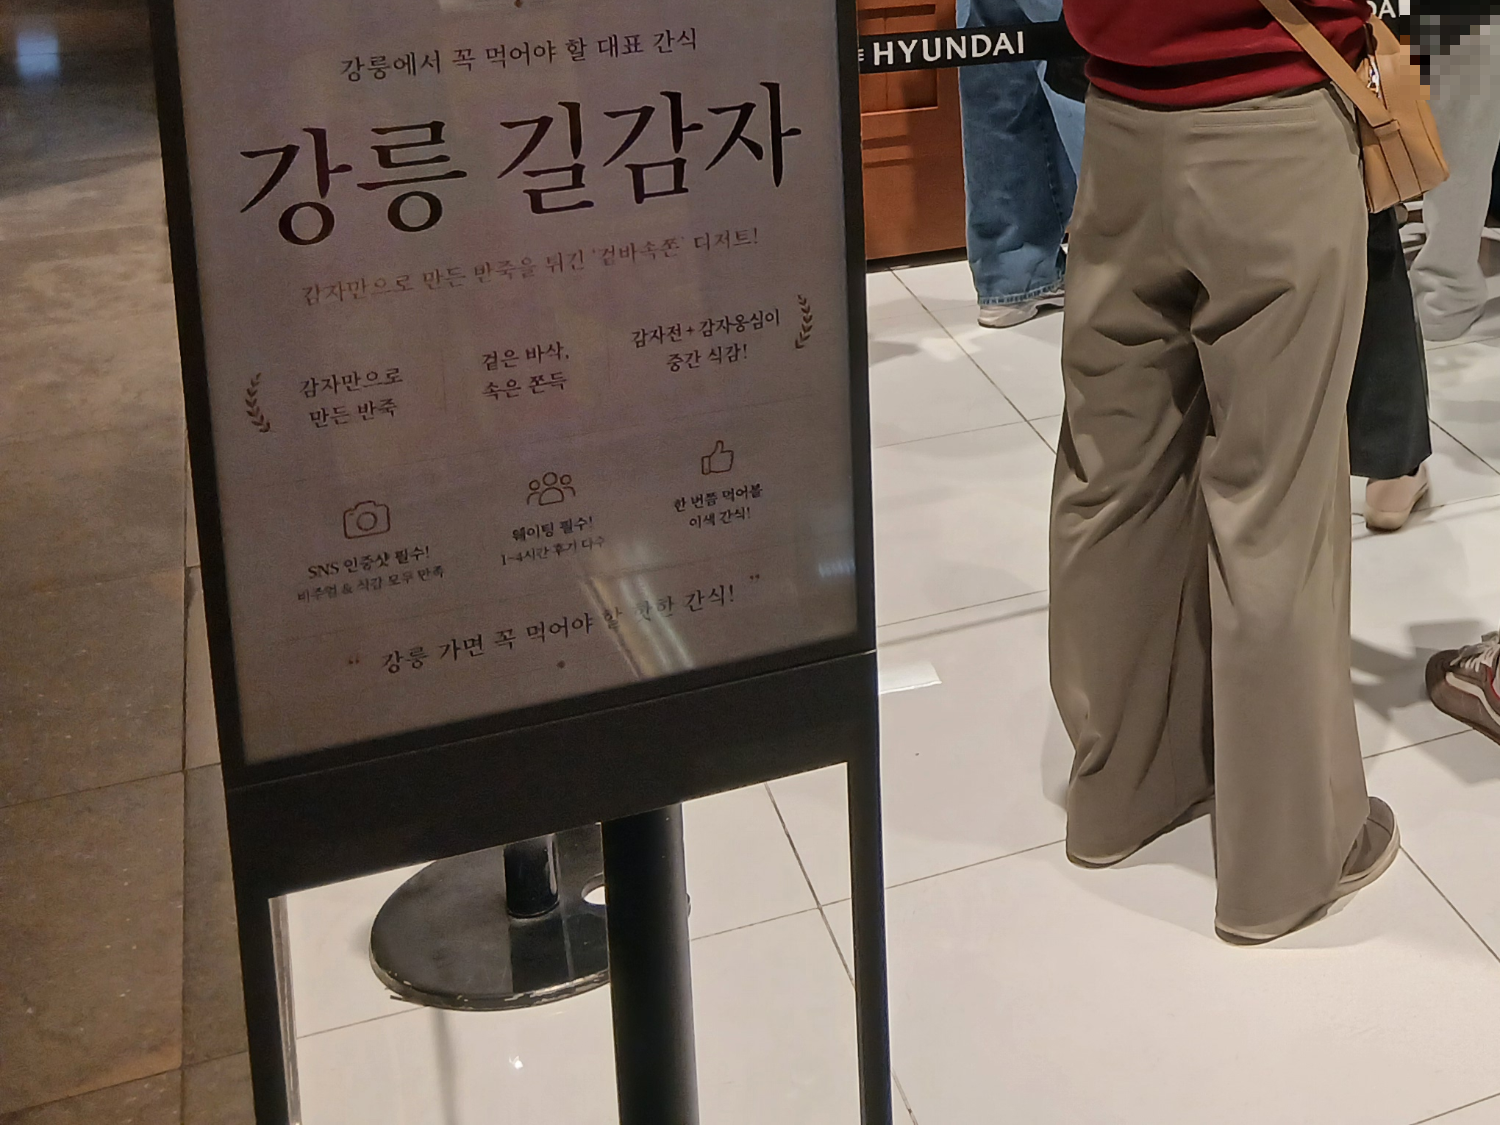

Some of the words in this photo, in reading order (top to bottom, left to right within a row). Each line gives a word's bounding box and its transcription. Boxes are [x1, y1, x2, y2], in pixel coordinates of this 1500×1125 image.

[342, 50, 440, 82] 강릉에서
[453, 48, 475, 71] 꼭
[486, 40, 556, 68] 먹어야
[565, 37, 587, 62] 할
[597, 34, 643, 58] 대표
[654, 28, 696, 53] 간식
[873, 30, 1025, 66] HYUNDAI
[240, 121, 467, 245] 강릉
[498, 82, 801, 214] 길감자
[302, 275, 413, 306] 감자만으로
[422, 267, 466, 290] 만든
[474, 257, 536, 283] 반죽을
[694, 227, 757, 251] 디저트!
[632, 323, 681, 348] 감자전
[699, 308, 779, 337] 감자옹심이
[482, 349, 520, 372] 겉은
[667, 350, 701, 372] 중간
[709, 342, 748, 364] 식감!
[300, 368, 404, 398] 감자만으로
[482, 378, 522, 400] 속은
[528, 371, 568, 395] 쫀득
[309, 407, 350, 429] 만든
[358, 398, 398, 421] 반죽
[674, 497, 686, 512] 한
[689, 513, 715, 528] 이색
[720, 507, 750, 524] 간식!
[512, 522, 554, 541] 웨이팅
[560, 516, 592, 534] 필수!
[308, 562, 339, 579] SNS
[344, 551, 391, 574] 인증샷
[395, 546, 429, 564] 필수!
[383, 646, 428, 674] 강릉
[440, 634, 483, 661] 가면
[494, 629, 516, 649] 꼭
[526, 613, 593, 642] 먹어야
[686, 584, 733, 612] 간식!
